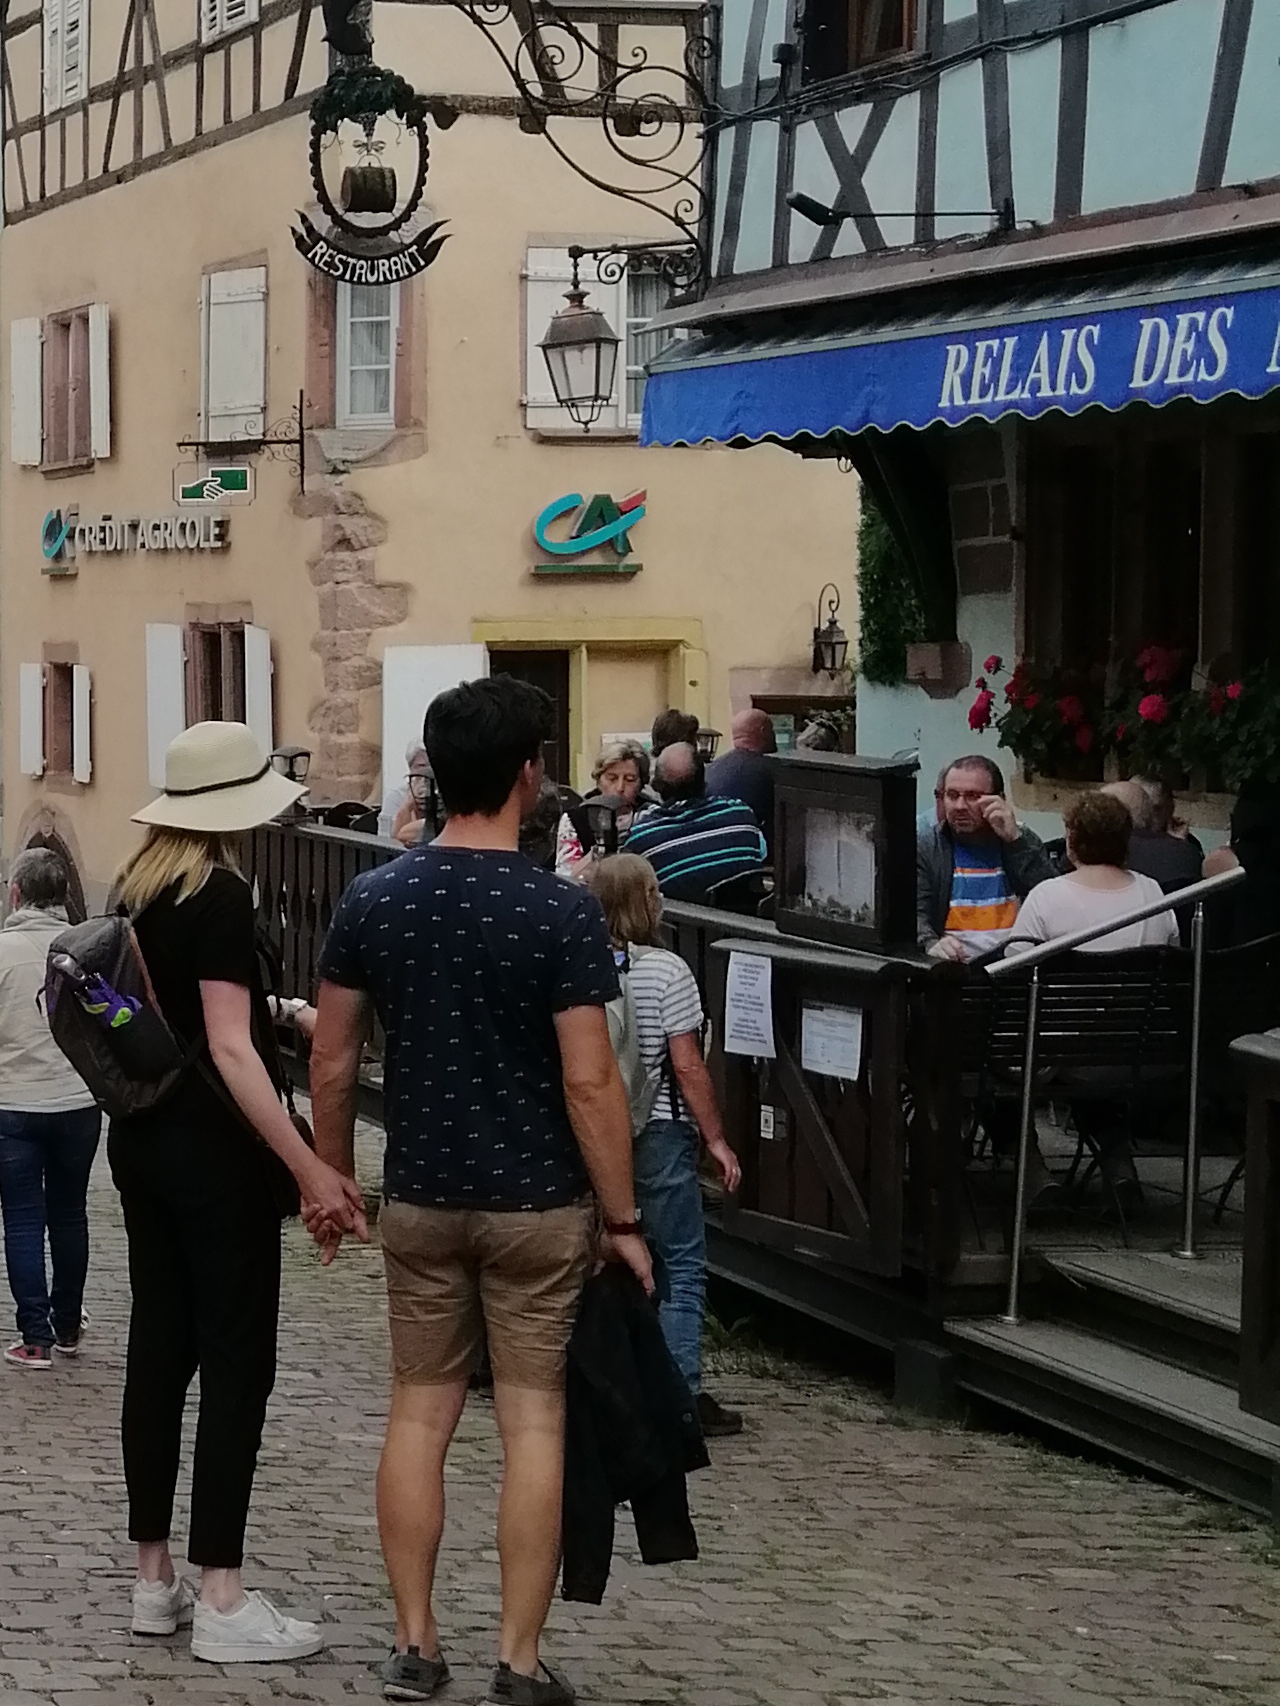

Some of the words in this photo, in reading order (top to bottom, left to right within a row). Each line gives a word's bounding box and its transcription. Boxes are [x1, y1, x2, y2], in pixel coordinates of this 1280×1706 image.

[307, 240, 426, 284] RESTAURANT
[938, 323, 1101, 407] RELAIS
[1129, 306, 1235, 388] DES
[137, 515, 224, 550] AGRICOLE
